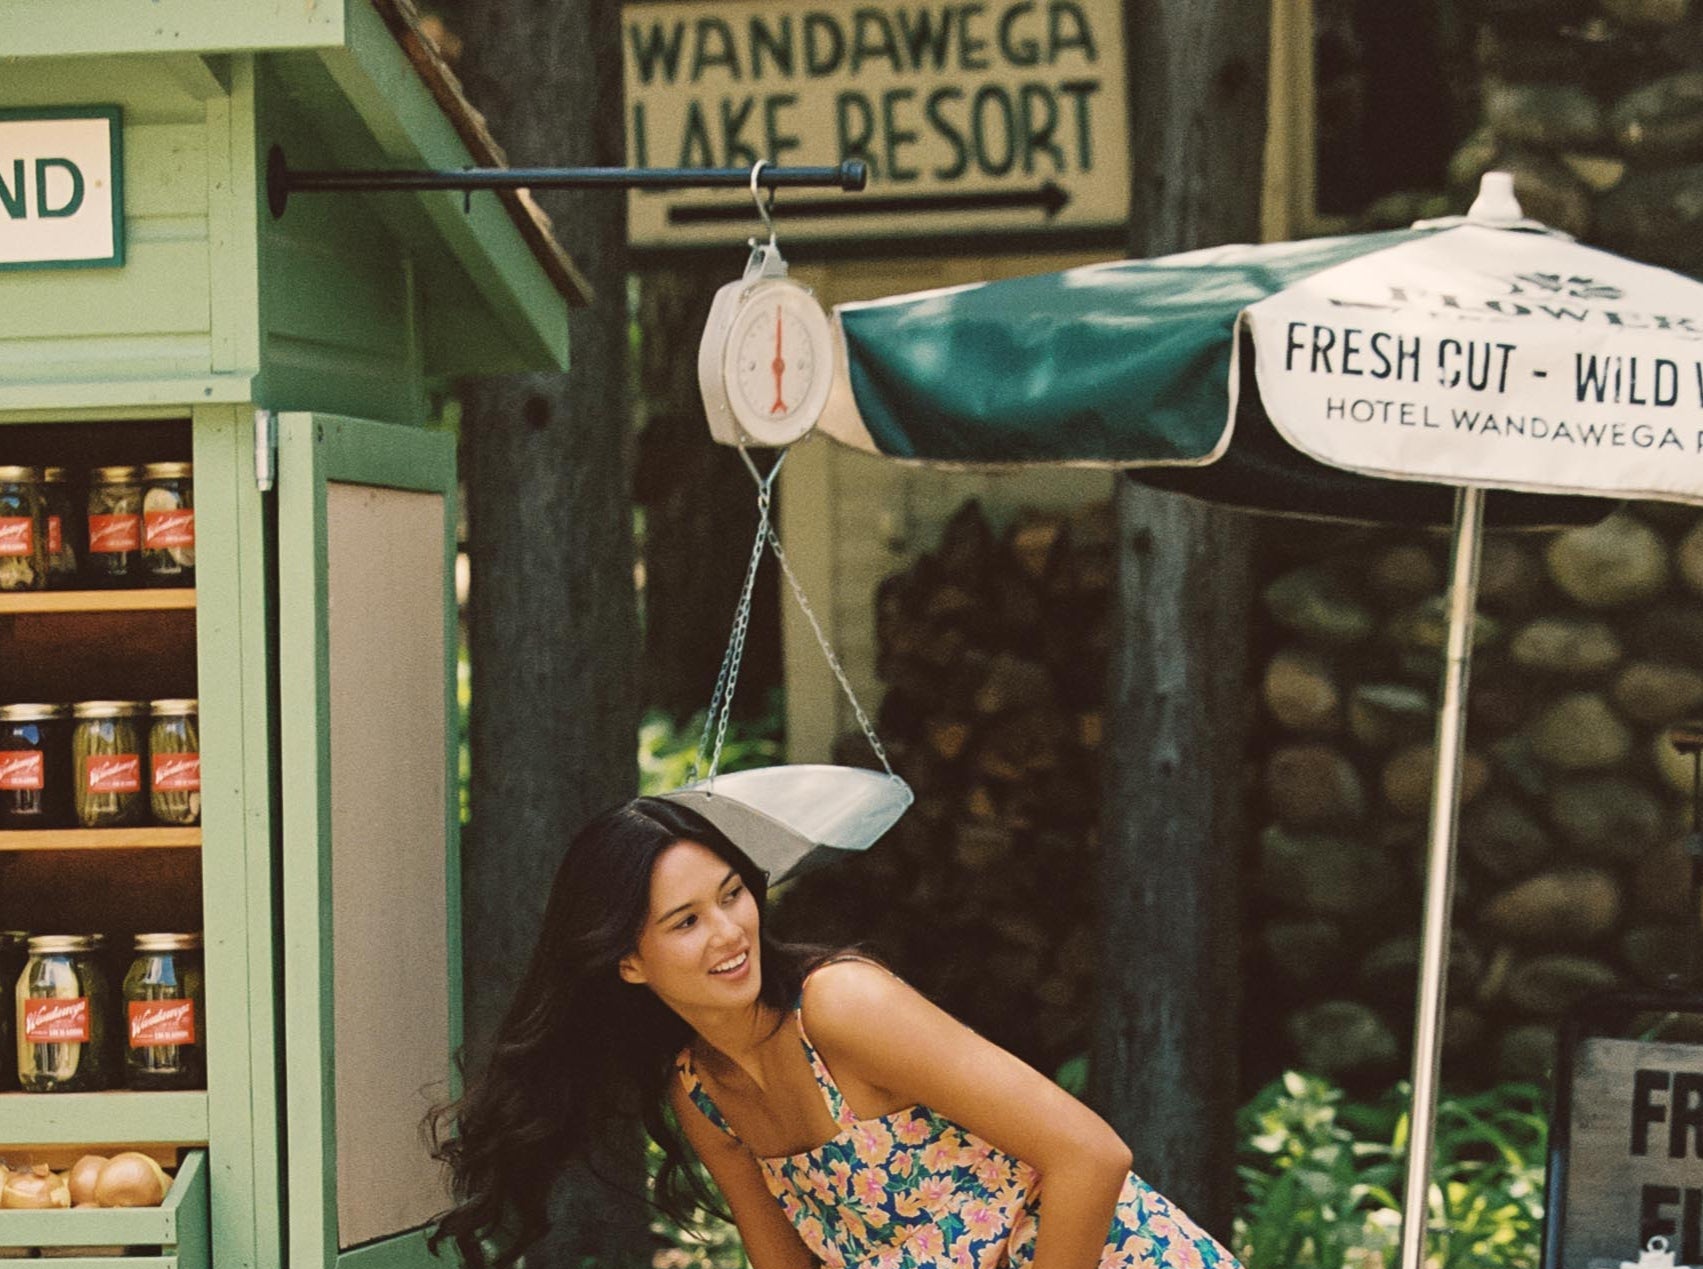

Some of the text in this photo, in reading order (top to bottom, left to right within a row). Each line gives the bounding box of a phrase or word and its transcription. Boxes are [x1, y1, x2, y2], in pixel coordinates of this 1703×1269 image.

[631, 1, 1097, 84] WANDAWEGA
[633, 80, 1099, 192] LAKE RESORT
[0, 157, 85, 219] ND
[1285, 321, 1421, 384] FRESH
[1438, 338, 1516, 394] CUT
[1575, 350, 1679, 408] WILD
[1326, 397, 1440, 429] HOTEL
[1451, 408, 1684, 451] WANDAWEGA
[1630, 1068, 1703, 1160] FR
